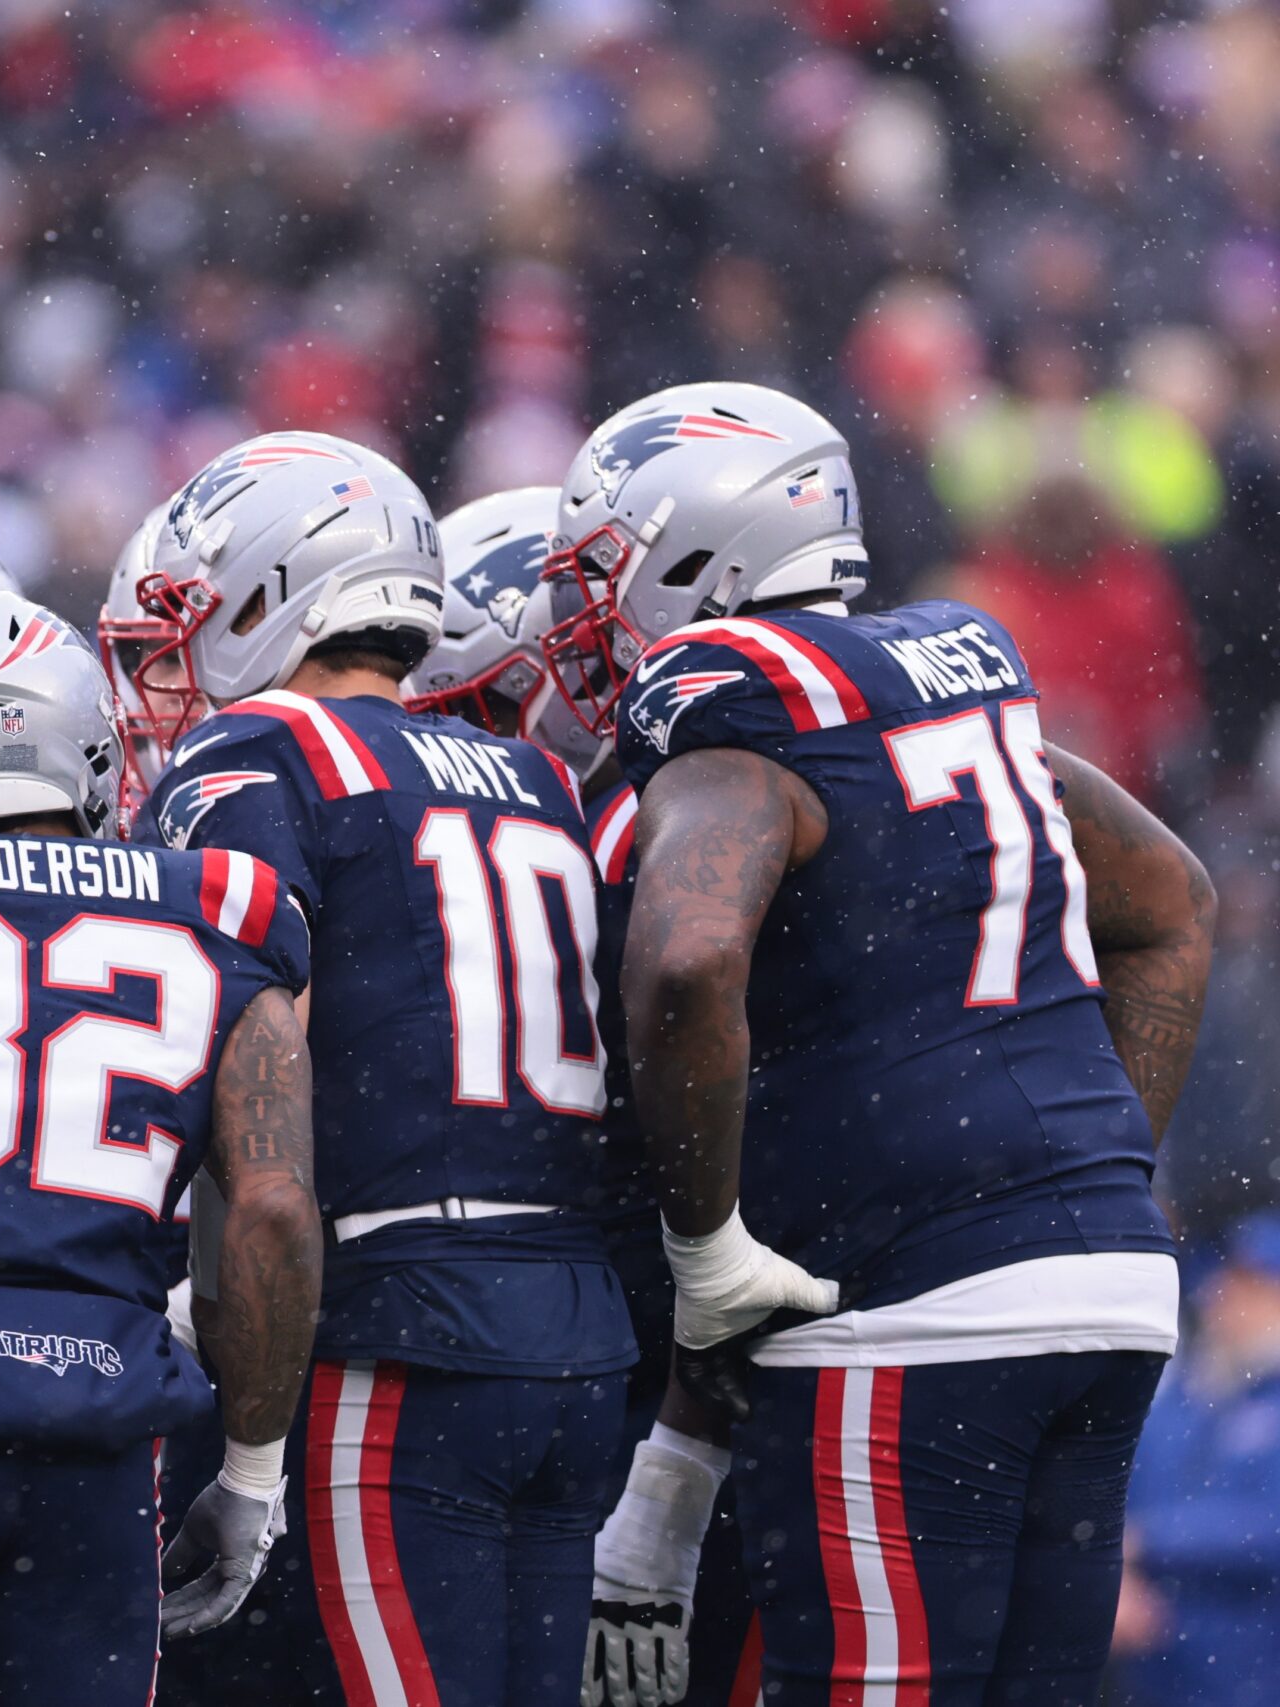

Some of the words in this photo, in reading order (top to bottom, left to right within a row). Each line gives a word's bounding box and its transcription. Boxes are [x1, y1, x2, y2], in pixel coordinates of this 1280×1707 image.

[411, 515, 439, 558] 10
[885, 621, 1020, 703] MOSES
[3, 718, 24, 731] NFL
[401, 730, 541, 807] MAYE
[413, 807, 608, 1120] 10
